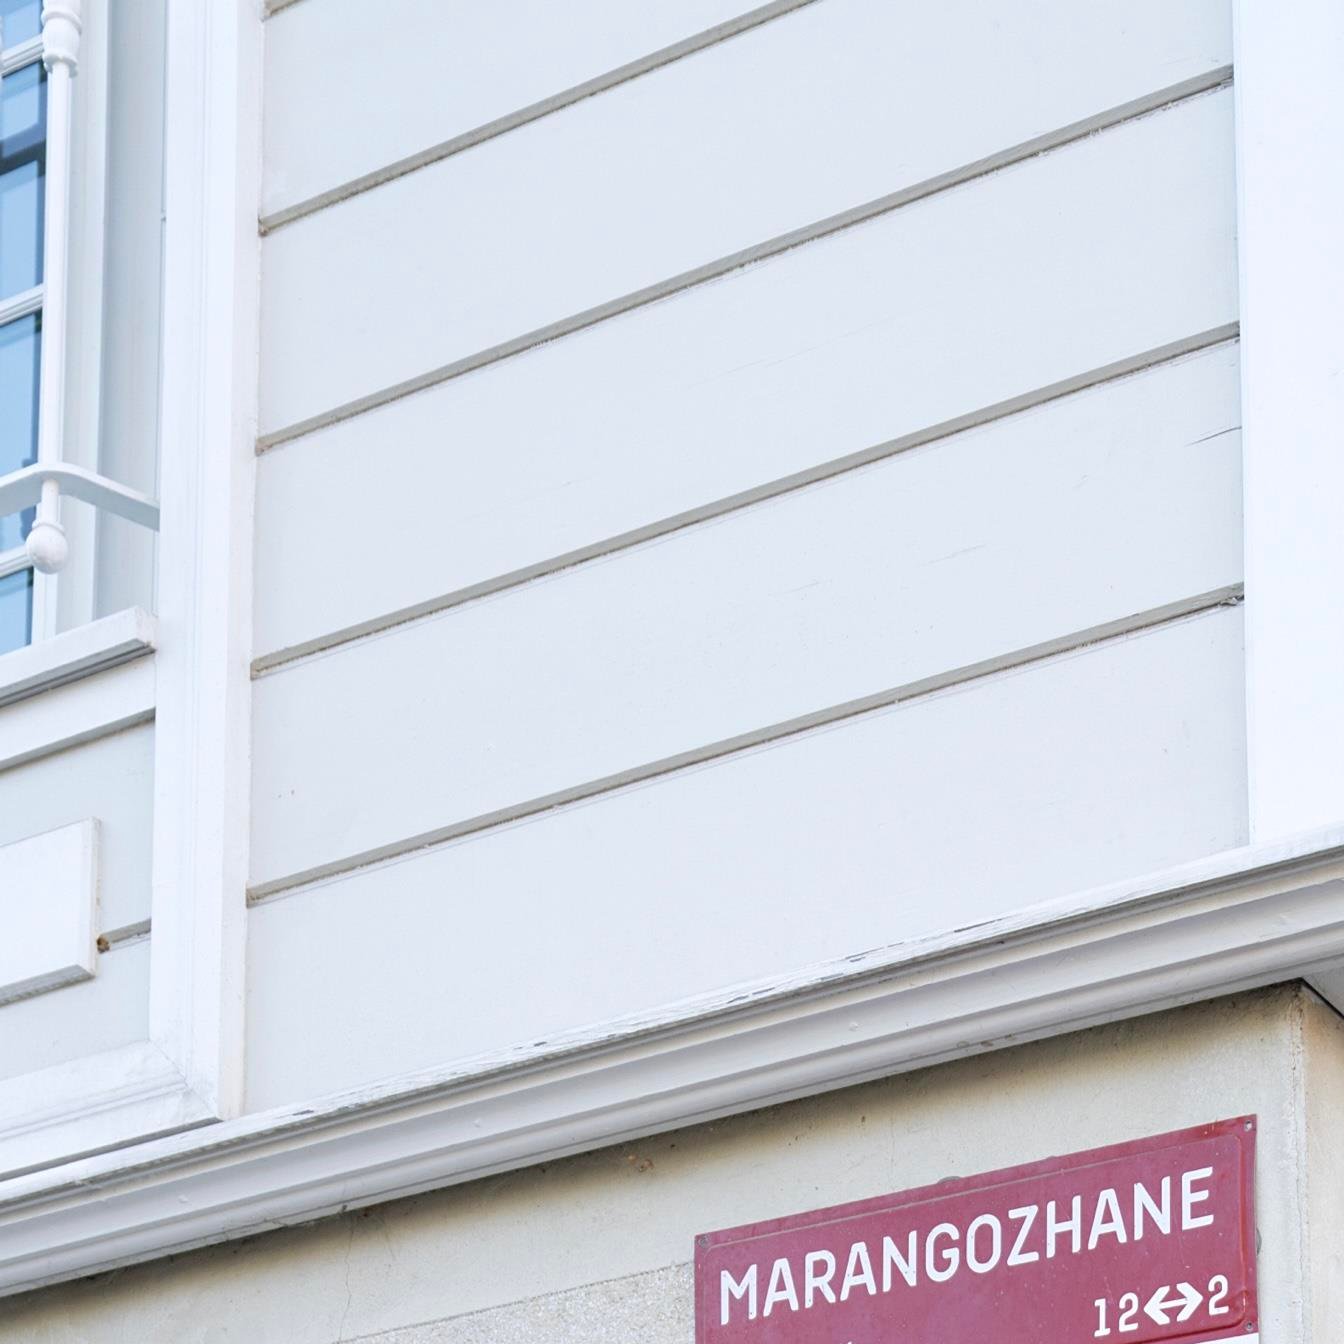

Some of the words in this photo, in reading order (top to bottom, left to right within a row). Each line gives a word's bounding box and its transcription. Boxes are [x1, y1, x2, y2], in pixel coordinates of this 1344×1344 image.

[720, 1166, 1214, 1325] MARANGOZHANE
[1094, 1292, 1139, 1337] 12
[1207, 1275, 1230, 1315] 2
